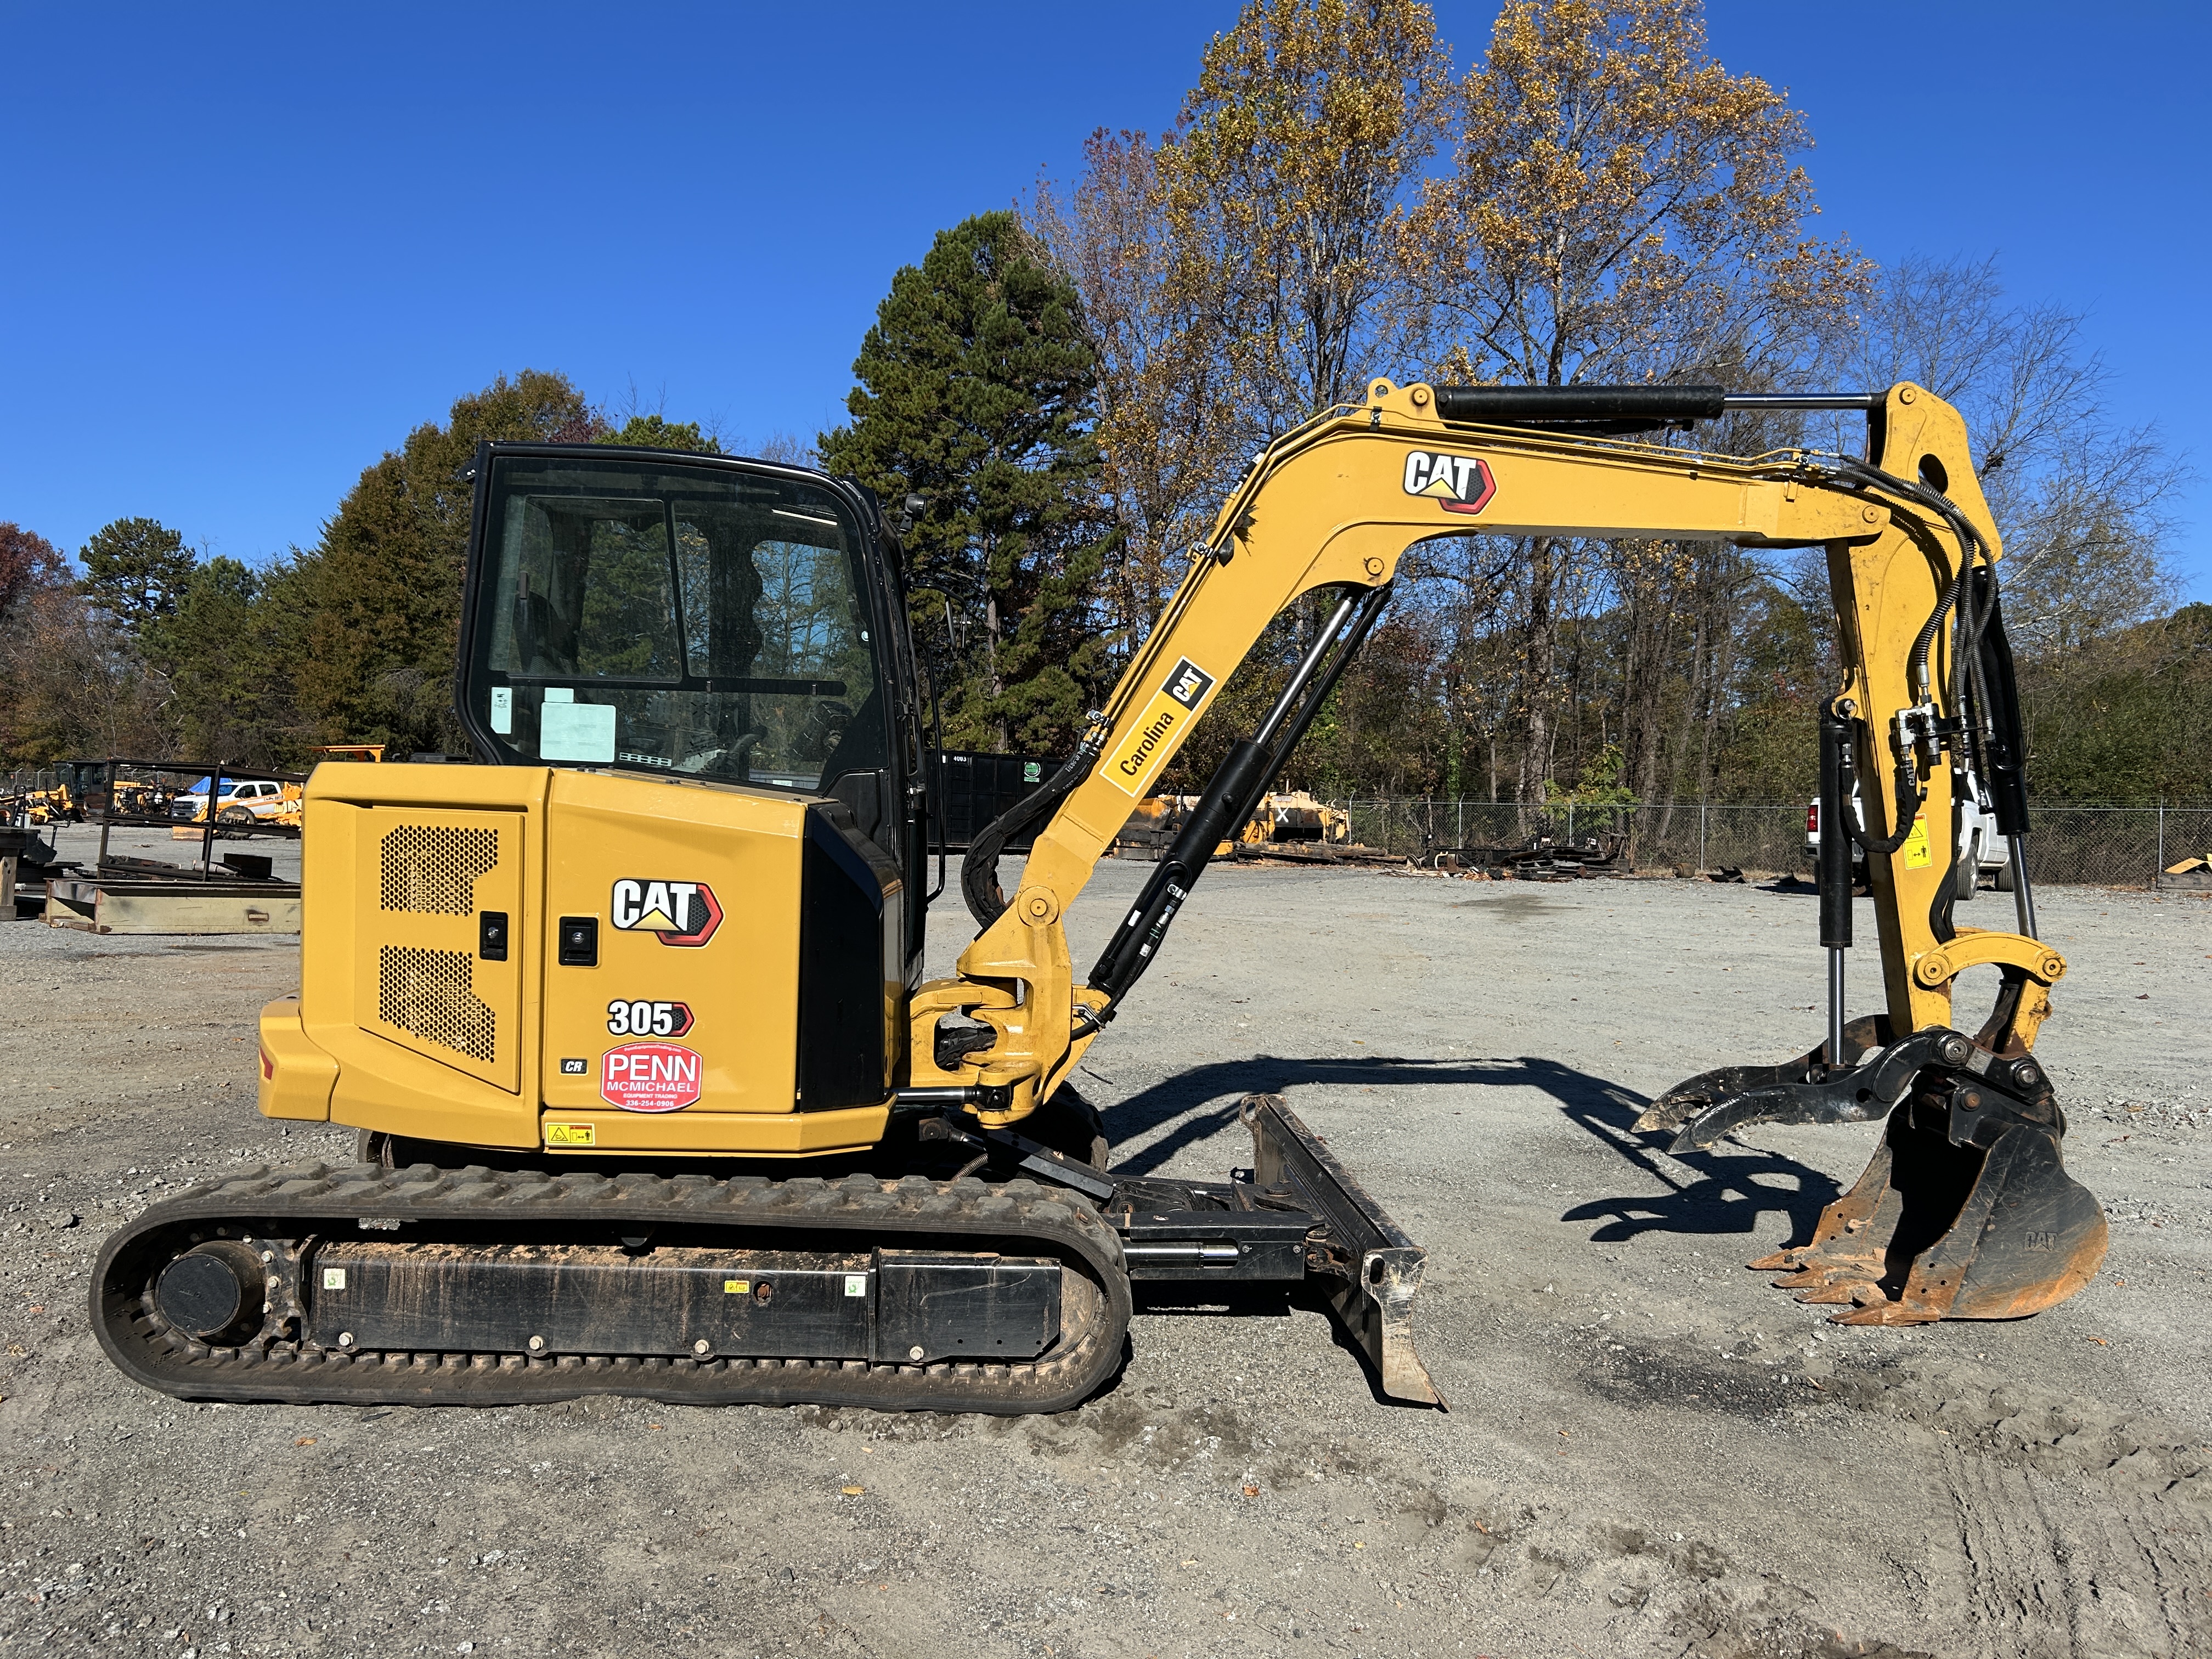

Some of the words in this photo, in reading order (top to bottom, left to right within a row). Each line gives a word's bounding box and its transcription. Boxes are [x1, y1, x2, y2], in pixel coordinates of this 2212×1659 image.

[1404, 452, 1477, 500] CAT
[1172, 667, 1203, 702] CAT
[1120, 713, 1175, 776] Carolina
[613, 880, 697, 931] CAT
[608, 1001, 673, 1035] 305
[565, 1061, 583, 1072] CR
[608, 1054, 696, 1082] PENN
[607, 1081, 695, 1092] MCMICHAEL
[2024, 1231, 2058, 1251] CAT
